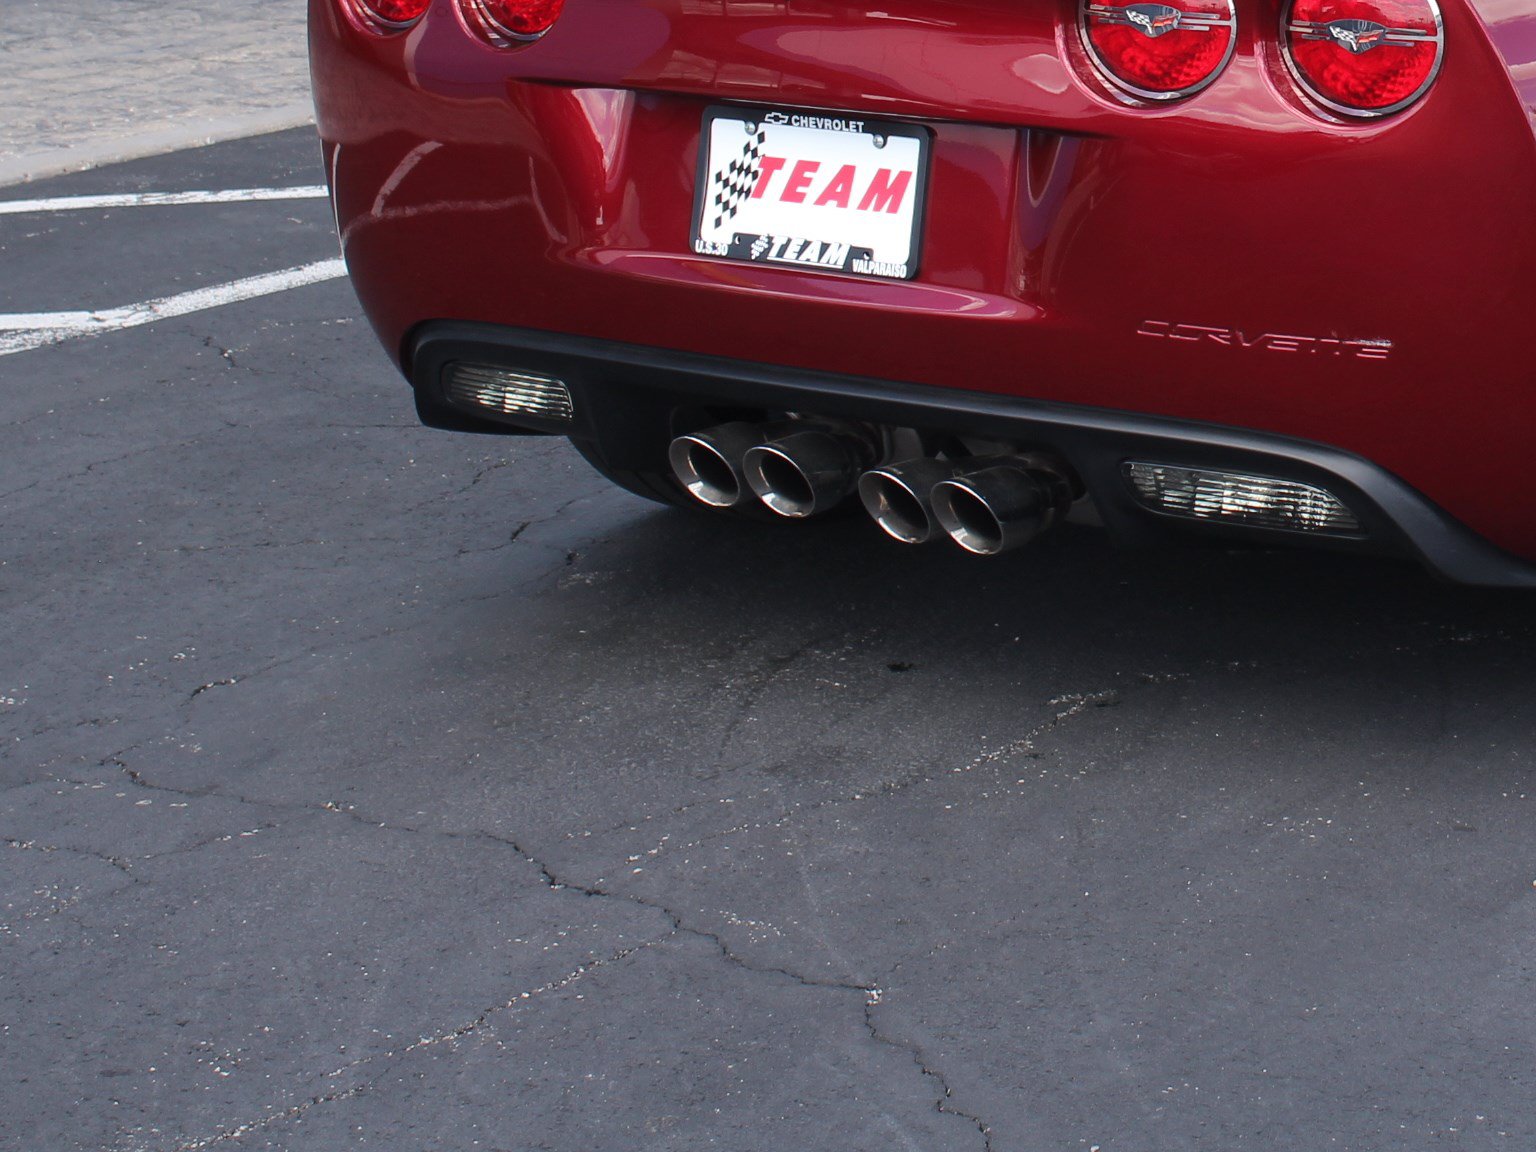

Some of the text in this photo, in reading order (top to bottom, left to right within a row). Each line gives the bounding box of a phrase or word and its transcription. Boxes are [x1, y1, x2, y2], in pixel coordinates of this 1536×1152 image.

[791, 115, 865, 133] CHEVROLET
[750, 155, 913, 214] TEAM
[768, 236, 850, 266] TEAM
[852, 258, 907, 279] VALPARAISO
